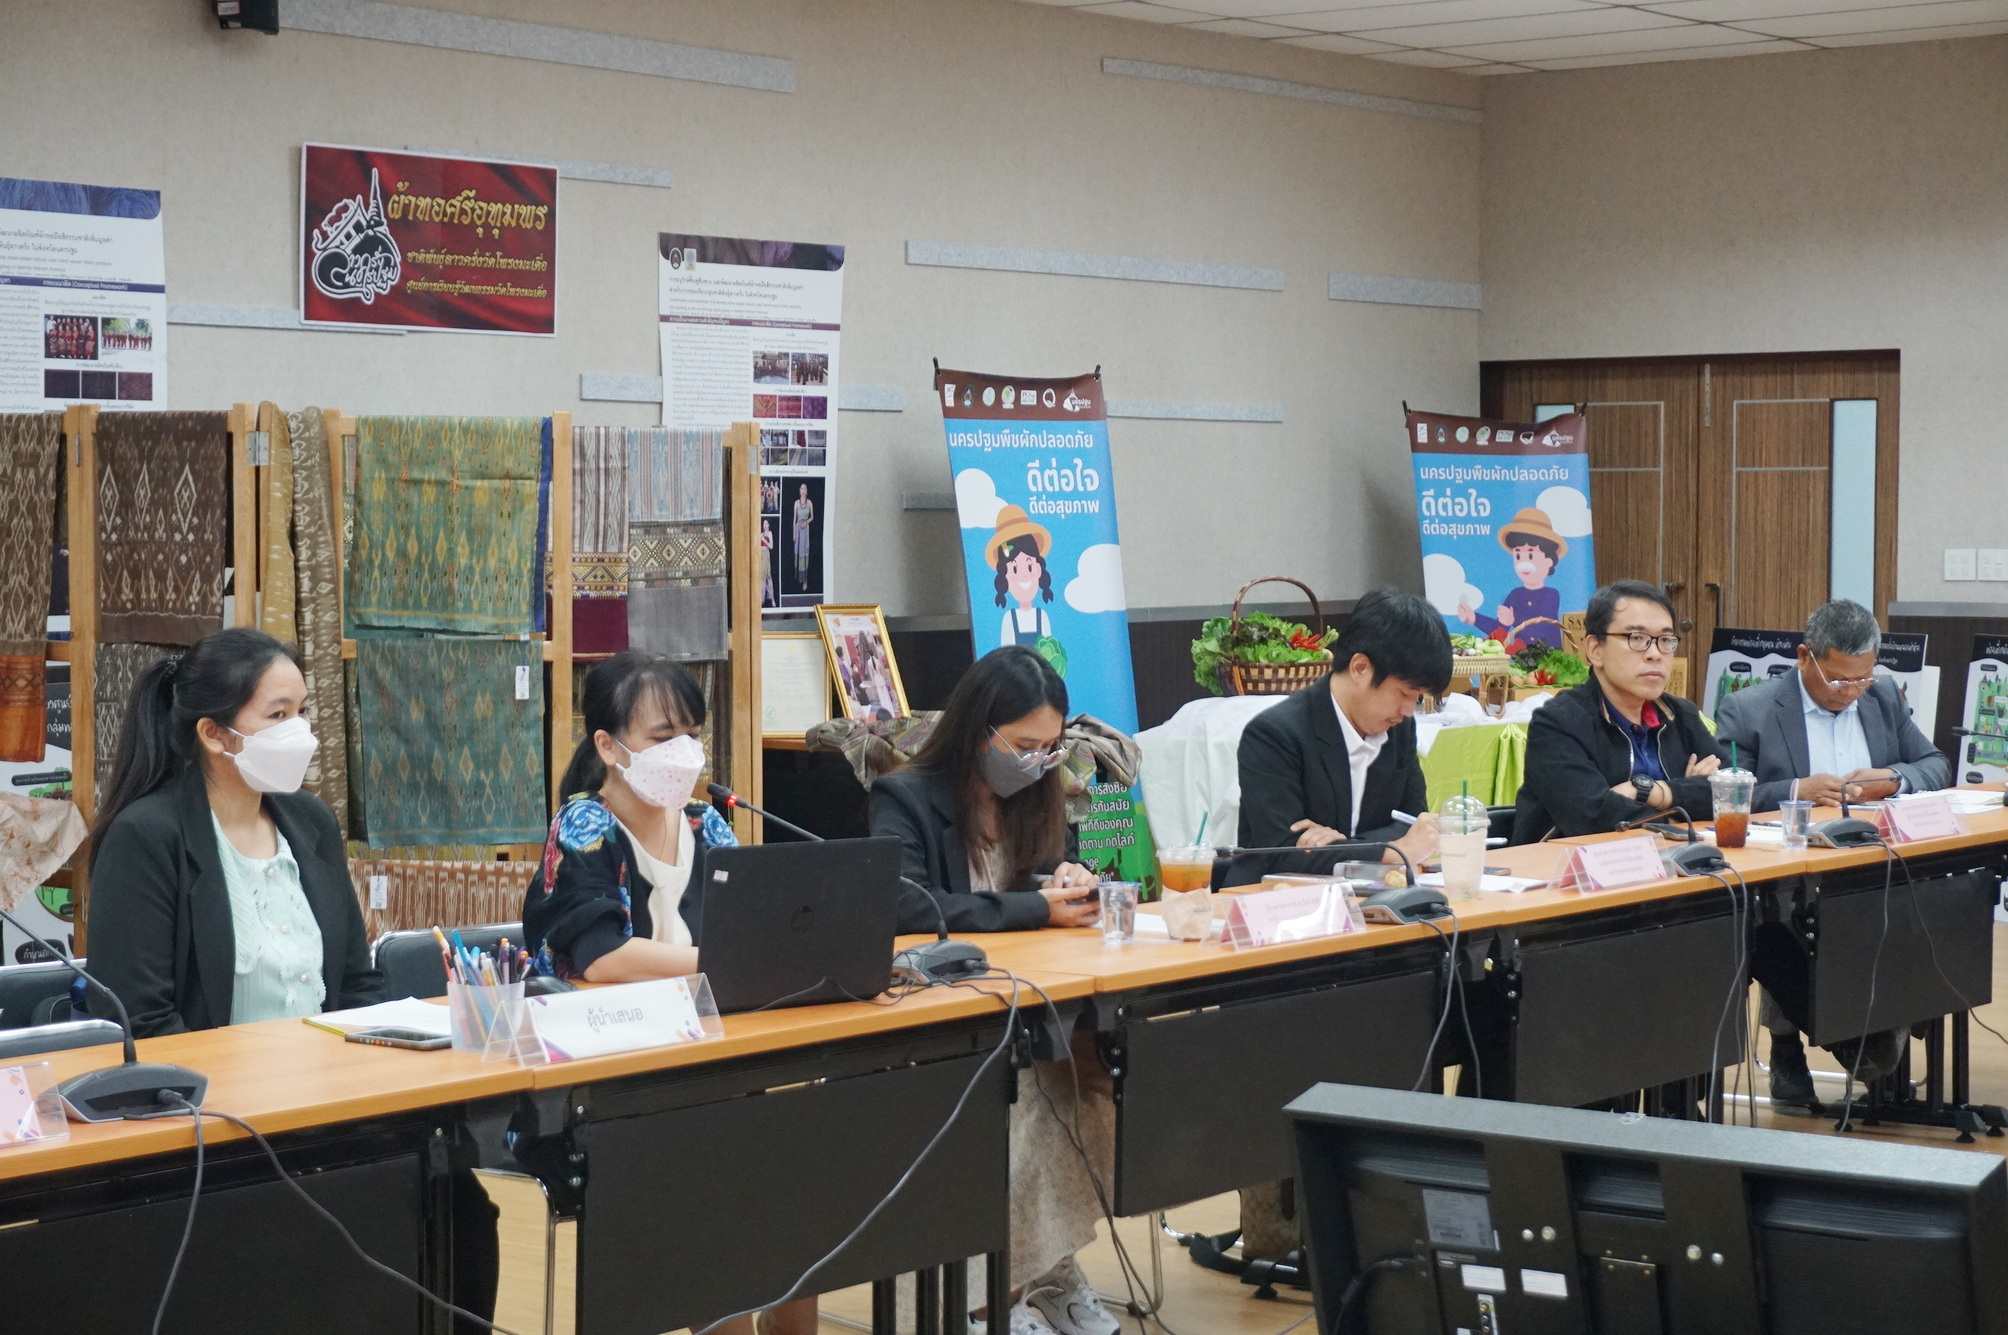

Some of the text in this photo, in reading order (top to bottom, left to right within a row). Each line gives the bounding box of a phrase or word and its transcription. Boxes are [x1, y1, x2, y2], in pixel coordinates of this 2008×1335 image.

[387, 181, 549, 239] ผ้าทอศรีอุทุมพร
[949, 428, 1094, 452] นครปฐมพืชผักปลอดภัย
[1026, 457, 1100, 493] ดีต่อใจ
[1420, 464, 1569, 484] นครปฐมพืชผักปลอดภัย
[1029, 494, 1100, 519] ดีต่อสุขภาพ
[1422, 488, 1491, 518] ดีต่อใจ
[1422, 517, 1491, 540] ดีต่อสุขภาพ
[1105, 833, 1135, 848] กดไลก์
[587, 1006, 644, 1033] ผู้นำเสนอ
